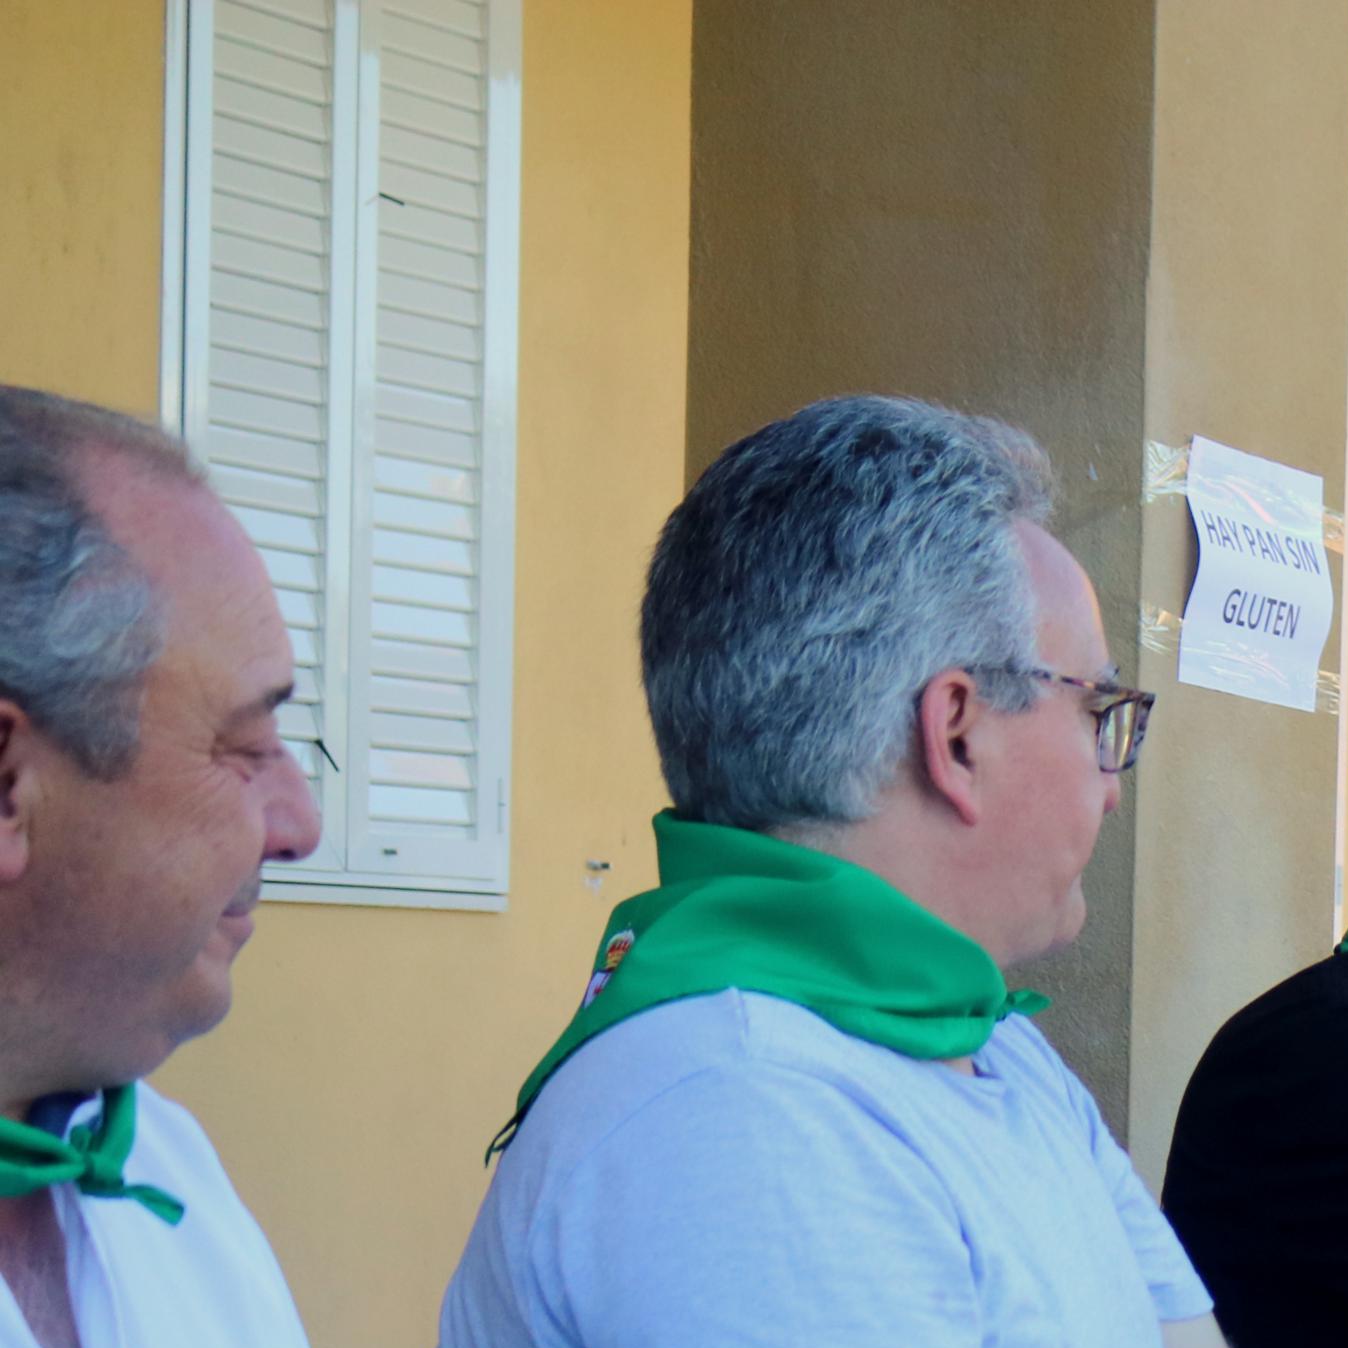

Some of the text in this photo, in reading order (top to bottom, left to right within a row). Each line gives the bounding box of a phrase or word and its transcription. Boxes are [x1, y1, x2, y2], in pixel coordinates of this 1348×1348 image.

[1201, 510, 1321, 575] HAY PAN SIN
[1222, 588, 1300, 639] GLUTEN
